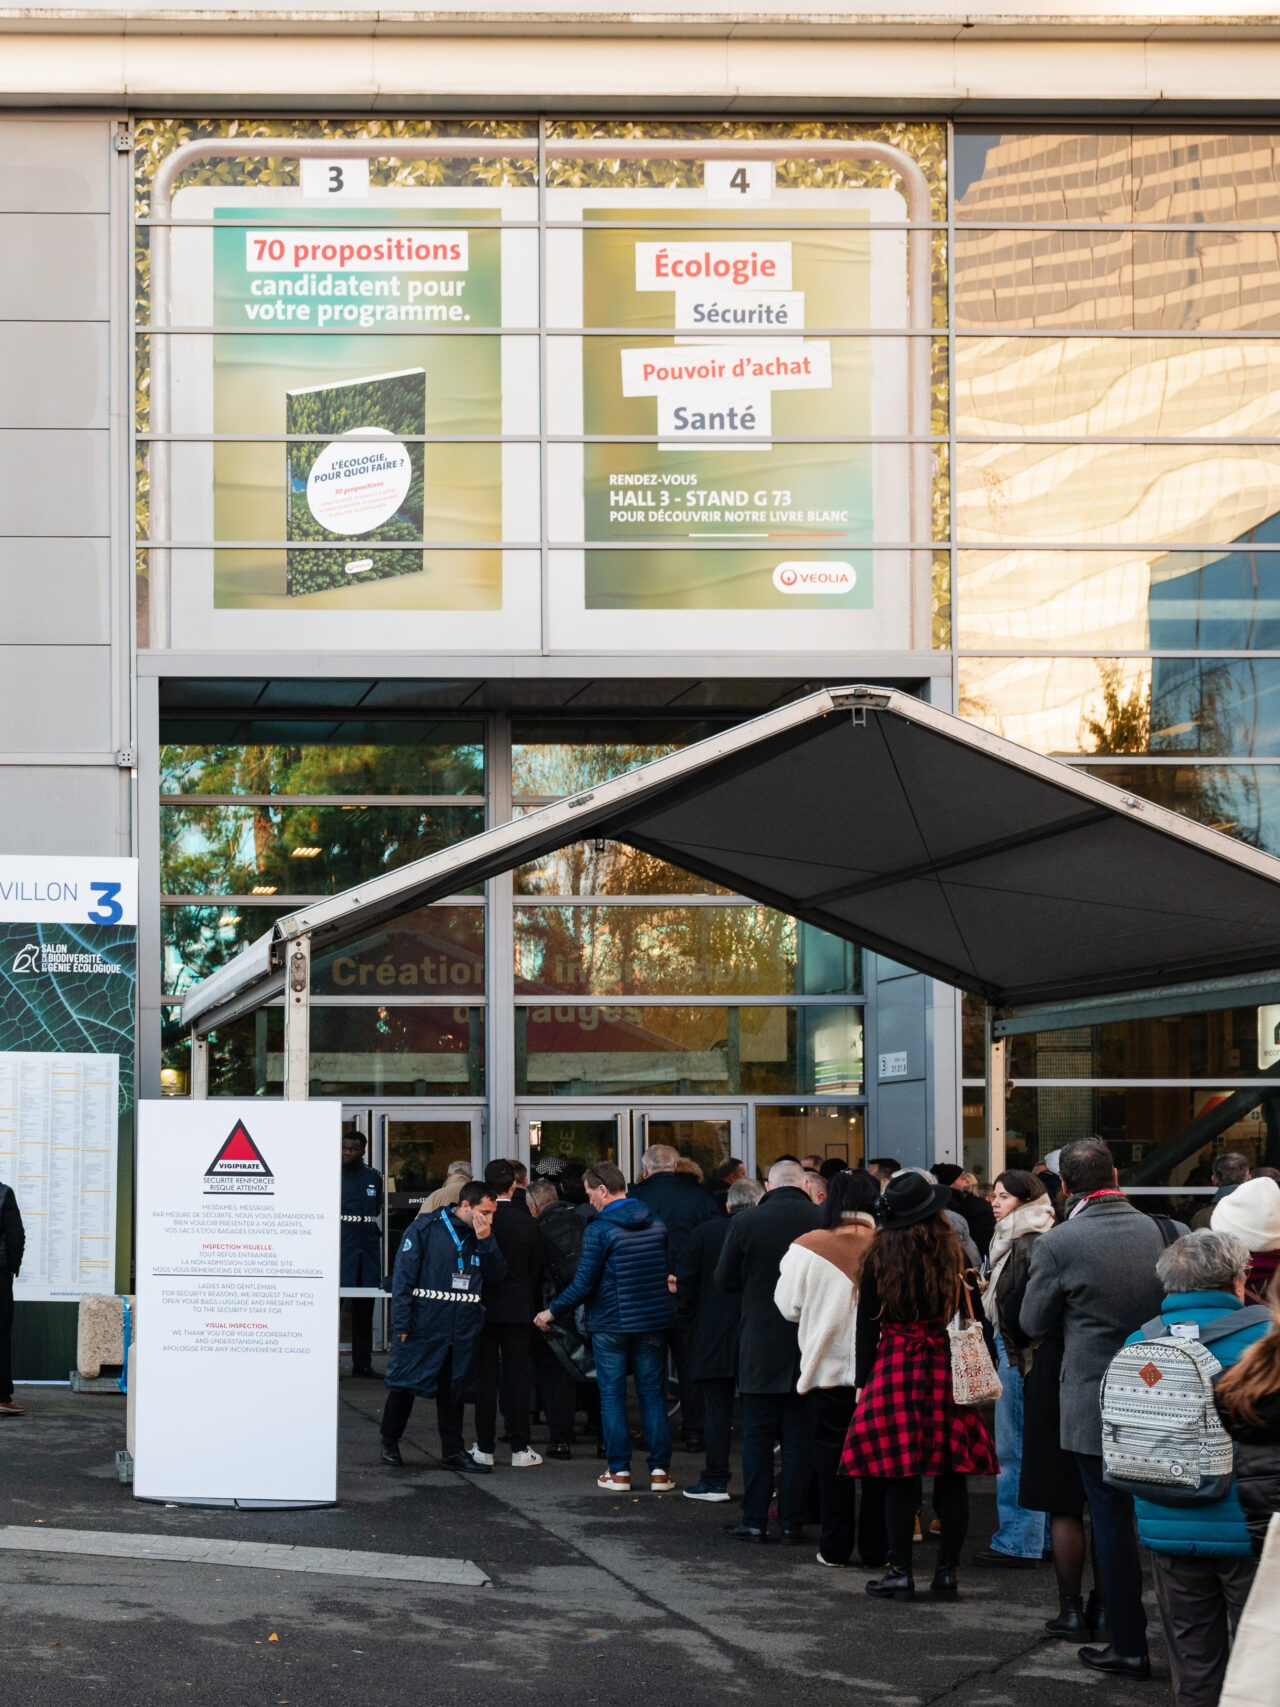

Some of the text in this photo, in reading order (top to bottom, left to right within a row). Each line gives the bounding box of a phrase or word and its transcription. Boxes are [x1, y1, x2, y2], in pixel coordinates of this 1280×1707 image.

[328, 166, 344, 192] 3
[730, 168, 750, 194] 4
[253, 238, 461, 267] 70 propositions
[655, 249, 776, 285] Écologie
[250, 274, 466, 302] candidatent pour
[245, 301, 471, 326] votre programme.
[693, 303, 788, 325] Sécurité
[643, 356, 812, 382] Pouvoir d’achat
[673, 405, 757, 431] Santé
[314, 471, 341, 483] POUR
[344, 466, 369, 479] QUOI
[372, 461, 397, 472] FAIRE
[609, 474, 698, 486] RENDEZ-VOUS
[609, 491, 656, 506] HALL
[660, 491, 670, 506] 3
[686, 490, 750, 506] STAND
[753, 491, 768, 506] G
[772, 491, 792, 506] 73
[609, 508, 849, 522] POUR DÉCOUVRIR NOTRE LIVRE BLANC
[800, 573, 849, 583] VEOLIA
[87, 881, 123, 926] 3
[41, 944, 67, 954] SALON
[48, 953, 102, 963] BIODIVERSITÉ
